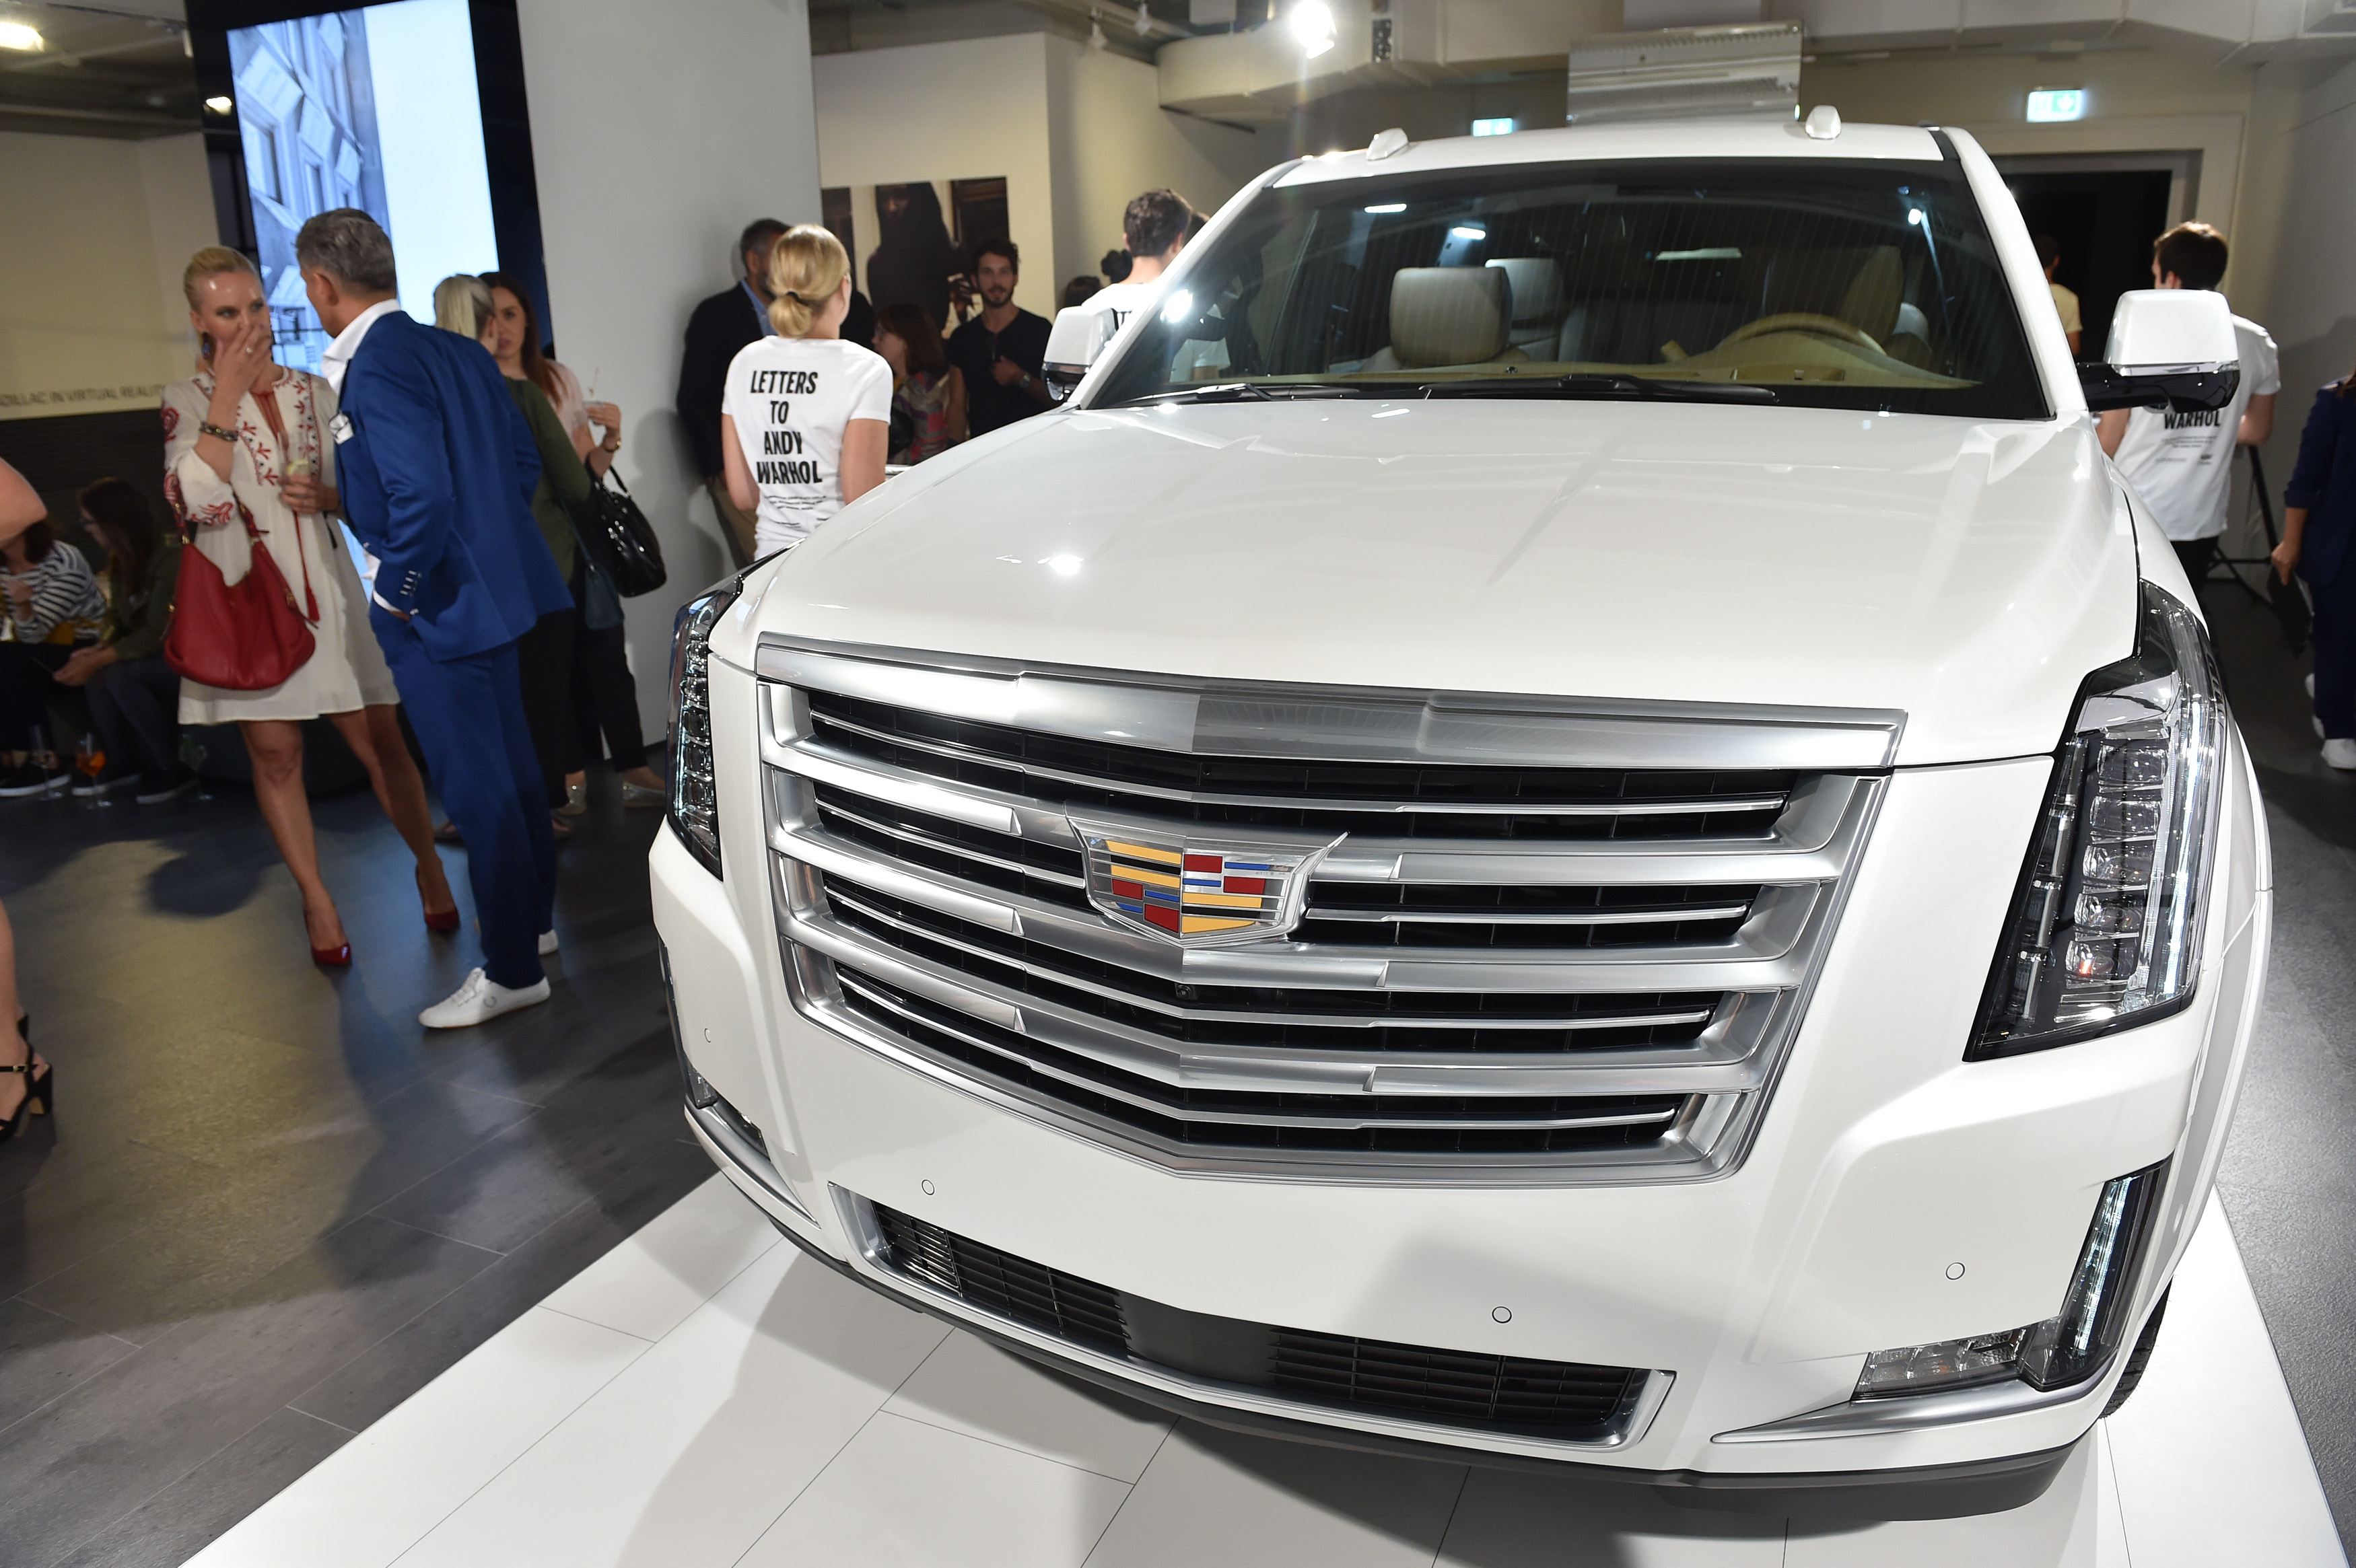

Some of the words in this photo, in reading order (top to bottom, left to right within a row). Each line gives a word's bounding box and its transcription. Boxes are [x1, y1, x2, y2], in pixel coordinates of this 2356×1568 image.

[750, 370, 819, 394] LETTERS
[770, 400, 790, 424] TO
[2164, 410, 2221, 429] WARHOL
[764, 431, 803, 455] ANDY
[756, 460, 823, 485] WARHOL
